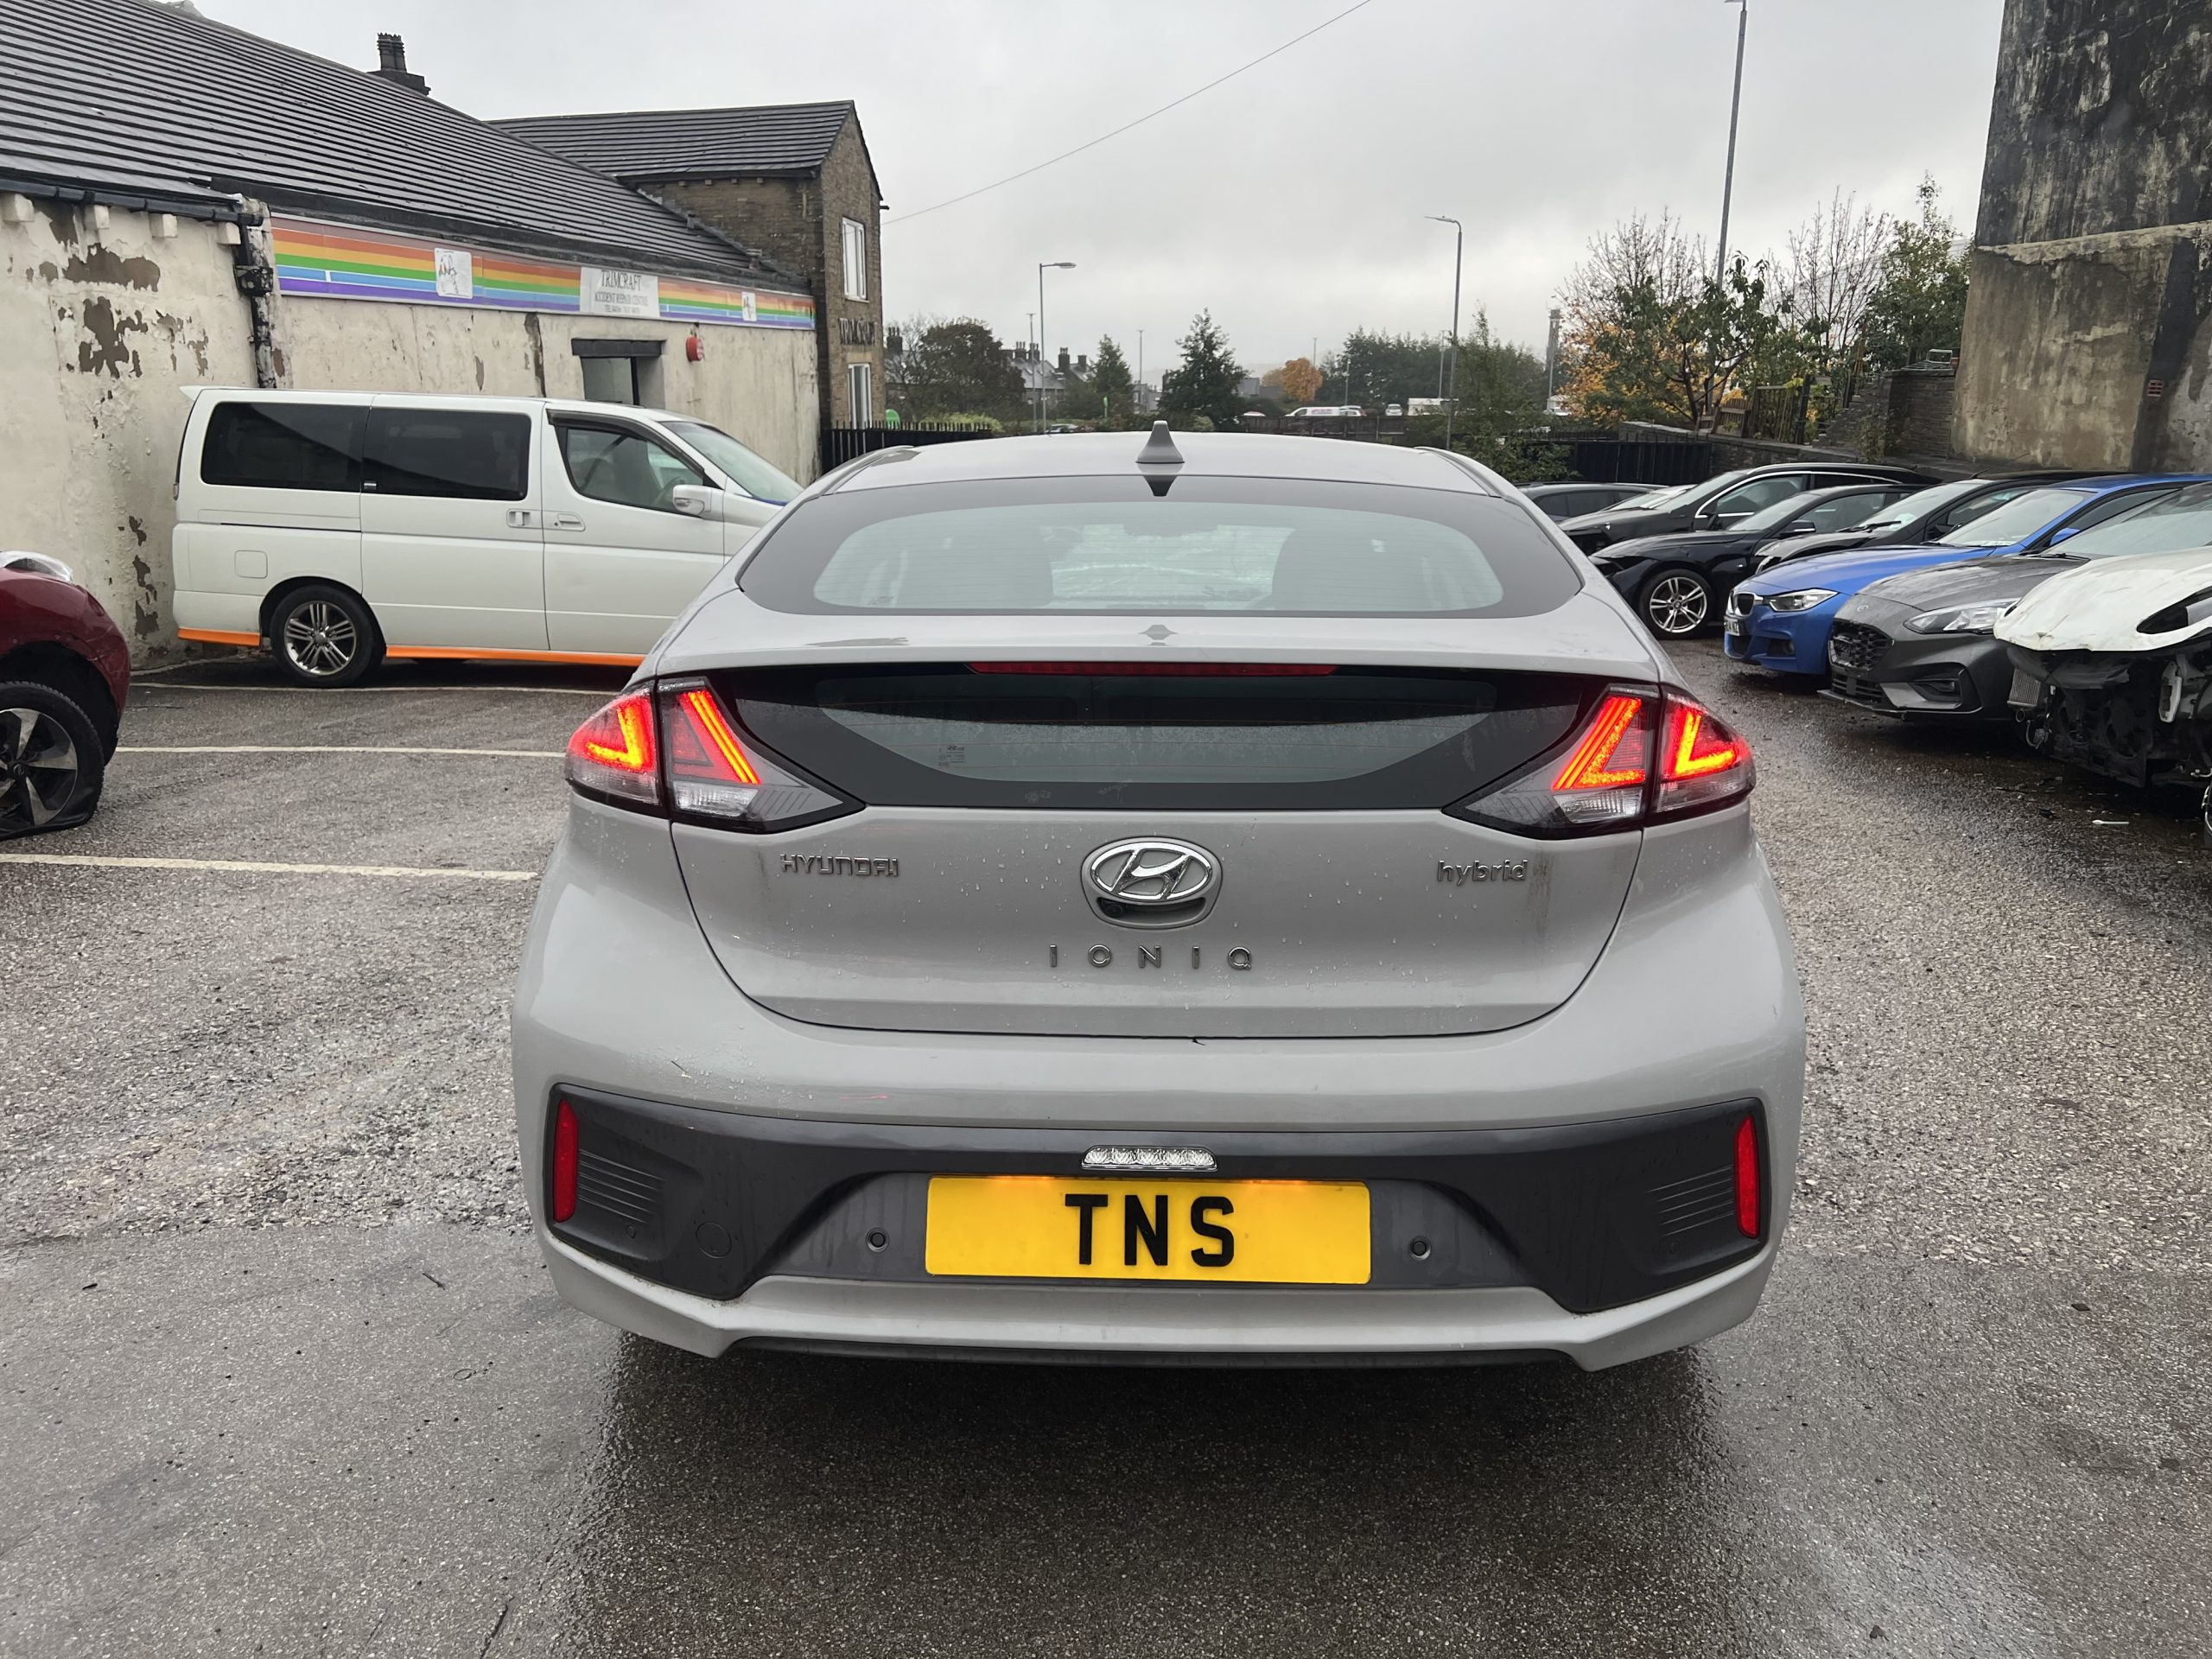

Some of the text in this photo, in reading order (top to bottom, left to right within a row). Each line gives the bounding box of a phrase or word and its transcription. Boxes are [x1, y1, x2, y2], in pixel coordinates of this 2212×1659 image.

[601, 269, 641, 290] TRIMCRAFT
[780, 854, 899, 877] HYUNDAI
[1438, 860, 1528, 886] hybrid
[1049, 944, 1252, 970] IONIQ
[1065, 1194, 1235, 1268] TNS
